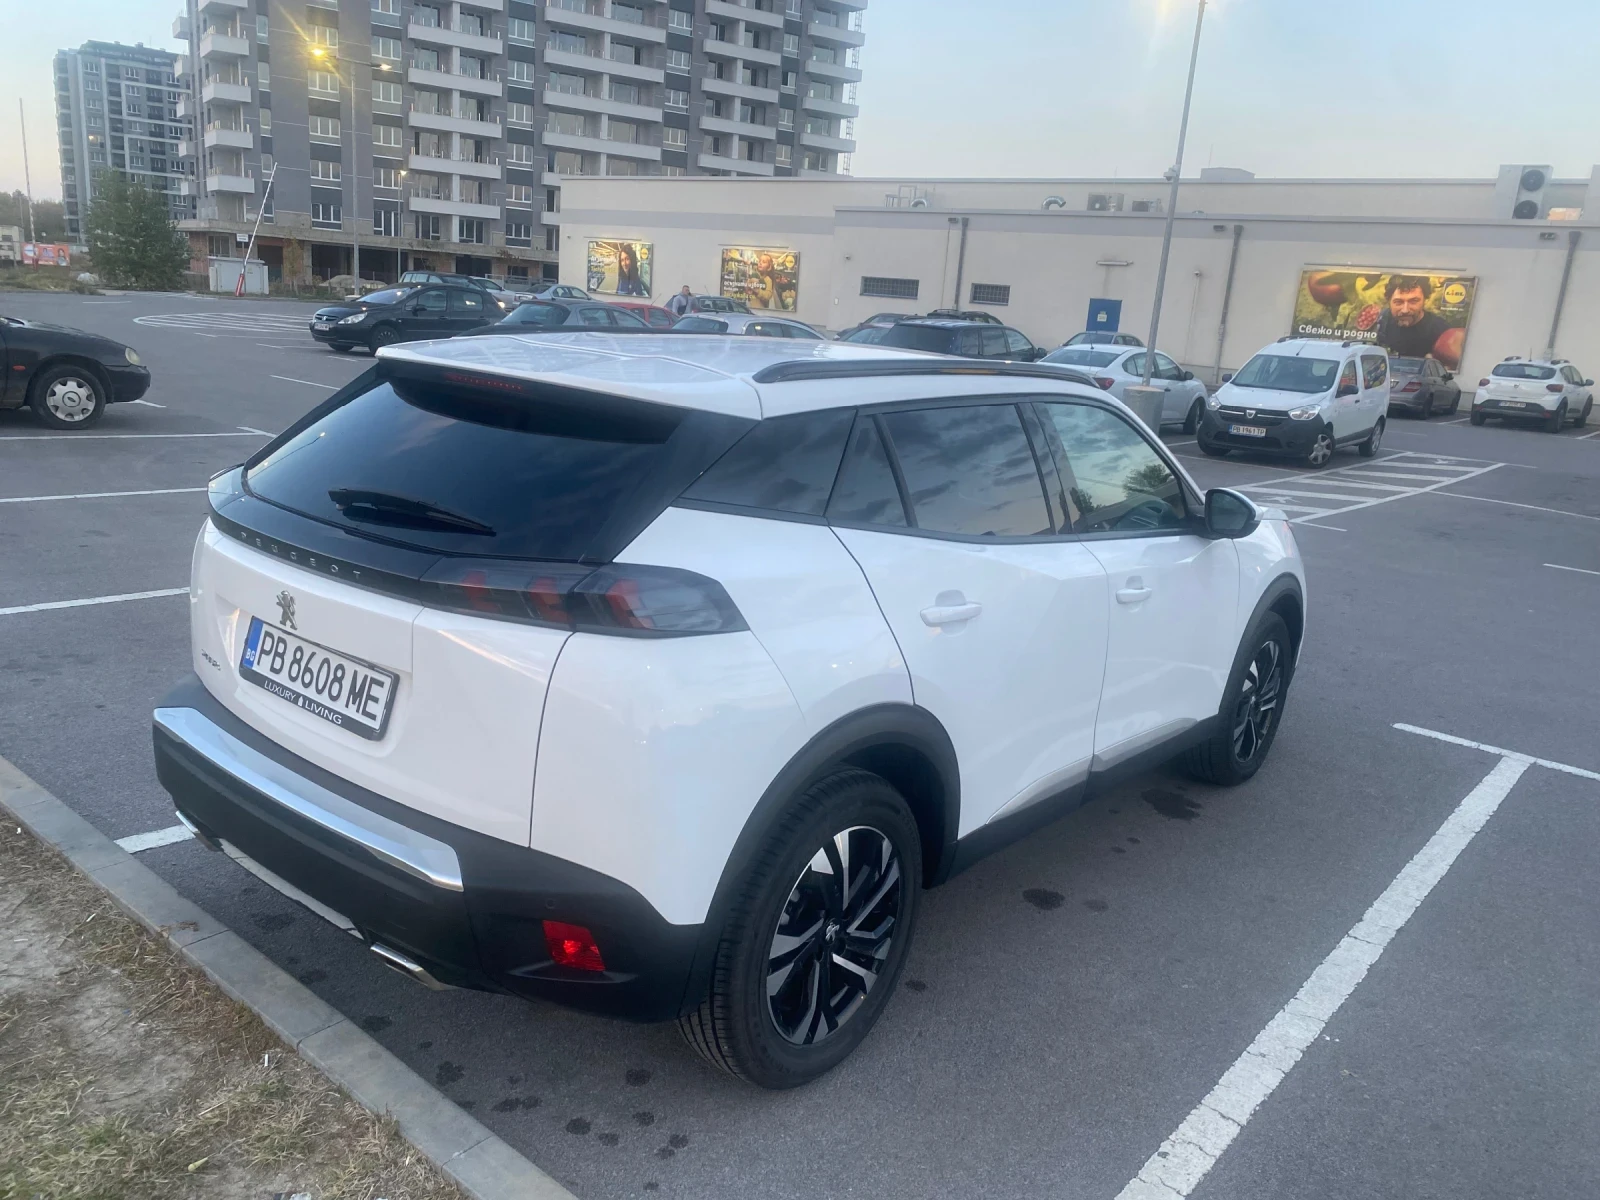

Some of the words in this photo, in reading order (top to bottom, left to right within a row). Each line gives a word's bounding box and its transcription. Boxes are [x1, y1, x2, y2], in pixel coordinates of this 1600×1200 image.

[1298, 324, 1332, 335] Свежо
[1334, 328, 1341, 336] и
[1343, 329, 1378, 340] родно
[240, 531, 361, 580] PEUGEOT
[245, 648, 256, 662] BG
[256, 630, 288, 675] PB
[288, 645, 346, 702] 8608
[345, 669, 385, 721] ME
[264, 680, 297, 701] LUXURY
[304, 700, 343, 725] LIVING
